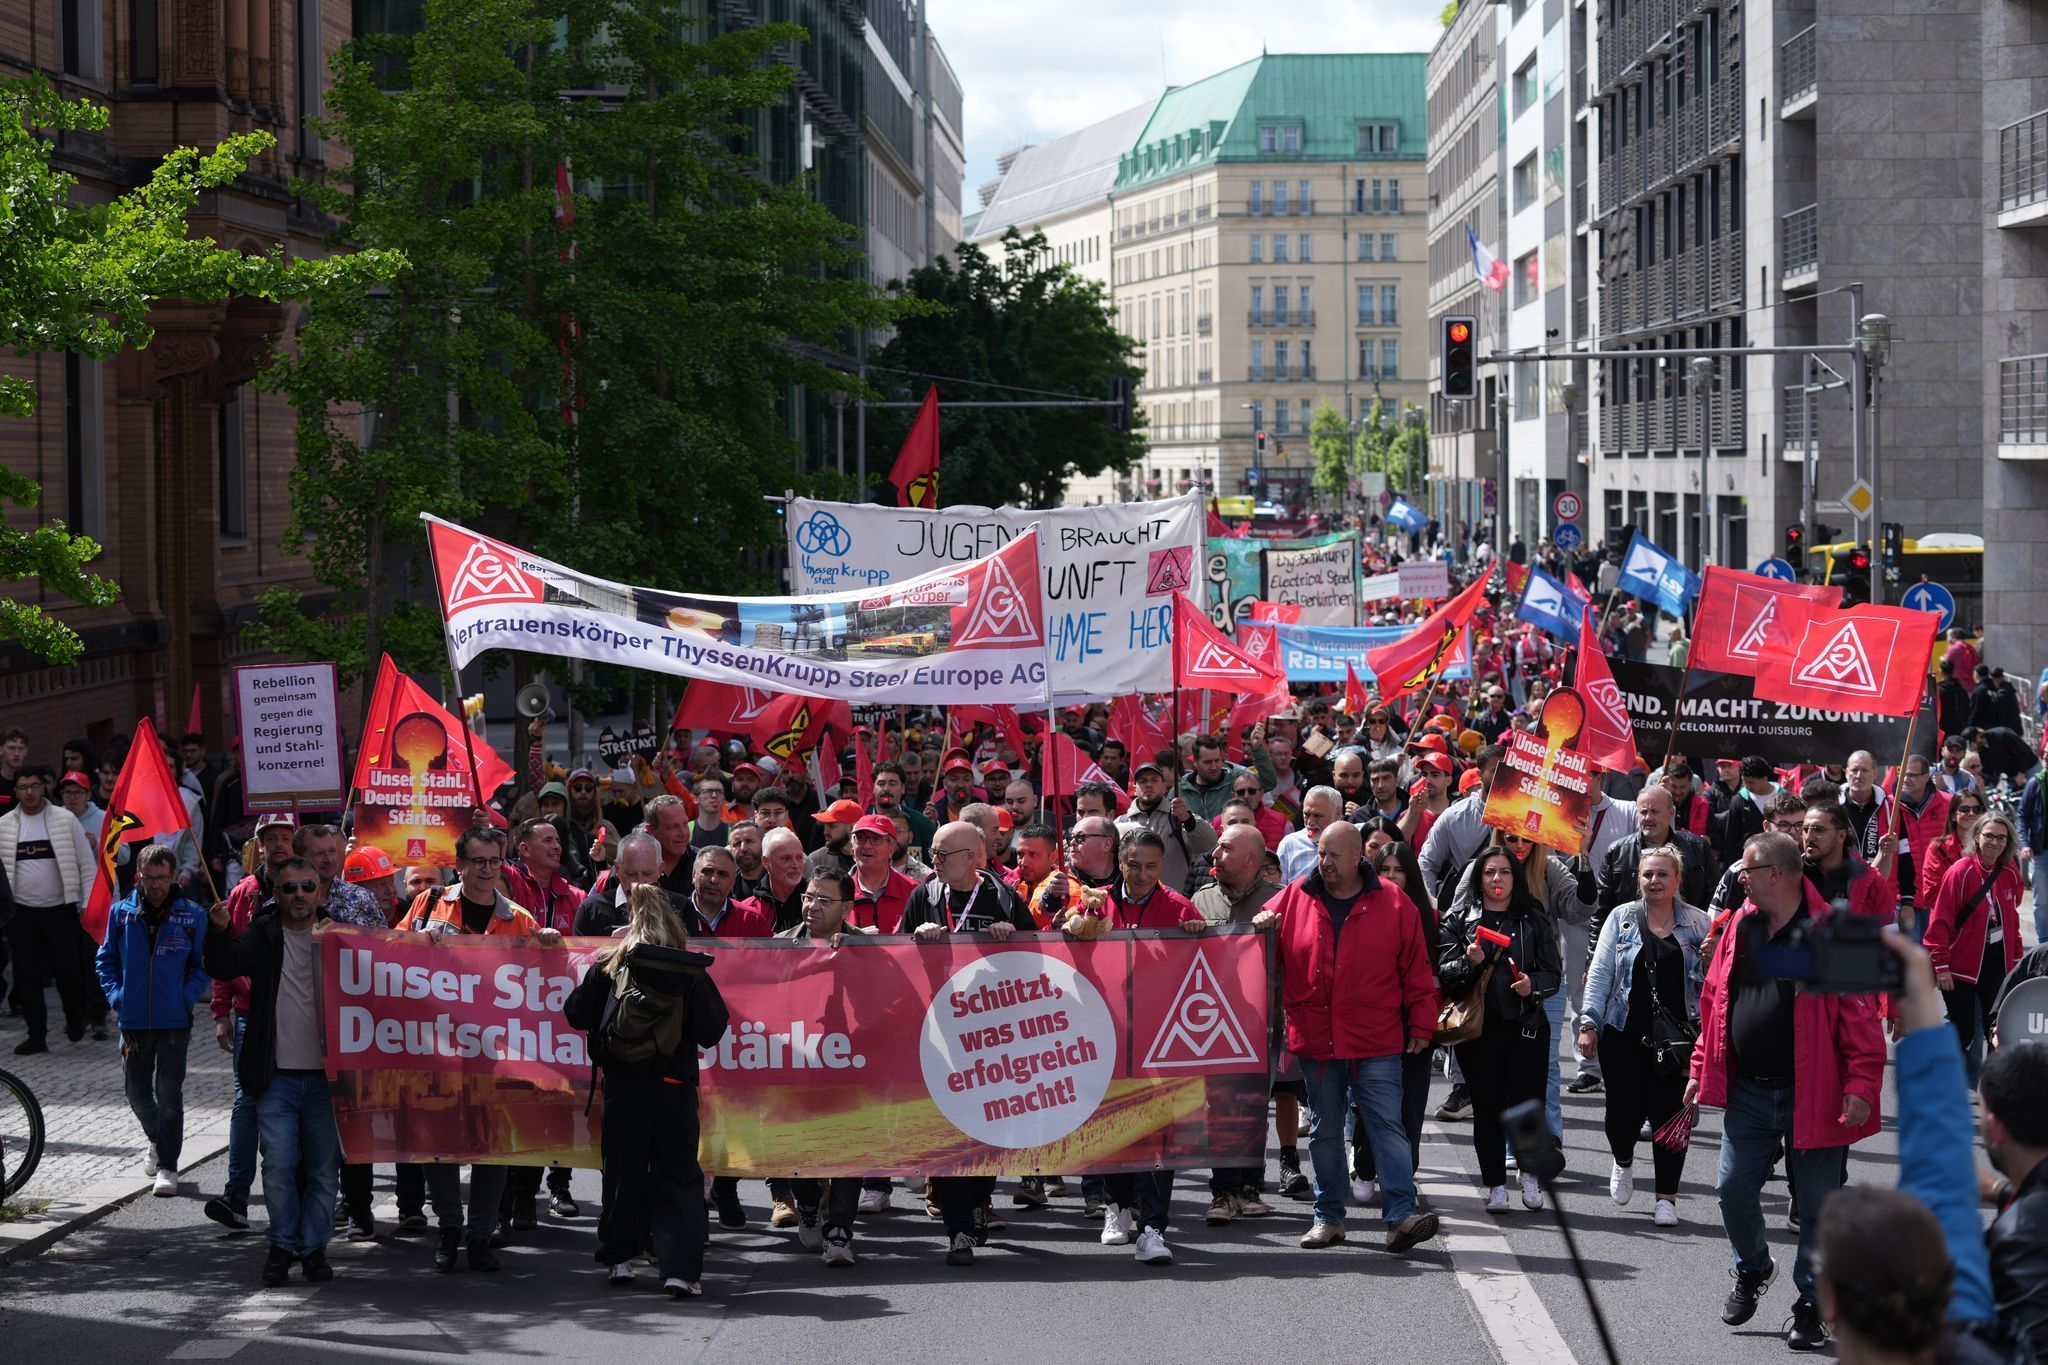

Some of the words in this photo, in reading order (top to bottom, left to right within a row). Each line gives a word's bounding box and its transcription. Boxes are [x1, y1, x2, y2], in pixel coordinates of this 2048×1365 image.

[1560, 501, 1576, 513] 30
[897, 519, 1026, 560] JUGEN
[1060, 519, 1170, 551] BRAUCHT
[1047, 561, 1136, 600] UNFT
[1270, 571, 1324, 589] Electrical
[1326, 568, 1354, 586] Steel
[1278, 591, 1355, 608] Gelsenkirchen
[1049, 612, 1107, 663] HME
[1129, 604, 1173, 649] HER
[450, 617, 653, 651] Vertrauenskörper
[660, 635, 842, 689] ThyssenKrupp
[848, 669, 908, 688] Steel
[913, 664, 1004, 691] Europe
[1010, 661, 1046, 685] AG
[1288, 650, 1371, 669] Rassel
[252, 675, 315, 689] Rebellion
[253, 691, 318, 707] gemeinsam
[1675, 698, 1768, 720] MACHT.
[260, 710, 294, 723] gegen
[296, 707, 314, 718] die
[253, 724, 323, 739] Regierung
[1629, 717, 1662, 730] GEND
[1664, 722, 1756, 735] ACELORMITTAL
[1758, 724, 1814, 737] DUISBURG
[256, 743, 282, 755] und
[285, 739, 325, 753] Stahl-
[1515, 733, 1550, 758] Unser
[1552, 749, 1588, 774] Stahl.
[257, 757, 325, 771] konzerne!
[1506, 752, 1588, 795] Deutschlands
[370, 770, 416, 787] Unser
[419, 772, 466, 789] Stahl.
[364, 789, 472, 808] Deutschlands
[1518, 776, 1563, 807] Stärke.
[388, 809, 446, 827] Stärke.
[1867, 816, 1878, 854] ERTRAUENS
[338, 947, 481, 1005] Unser
[493, 963, 589, 1012] Sta
[948, 971, 1064, 1018] Schützt,
[957, 1024, 1014, 1053] was
[1018, 1010, 1070, 1037] uns
[946, 1035, 1098, 1093] erfolgreich
[983, 1075, 1078, 1122] macht!
